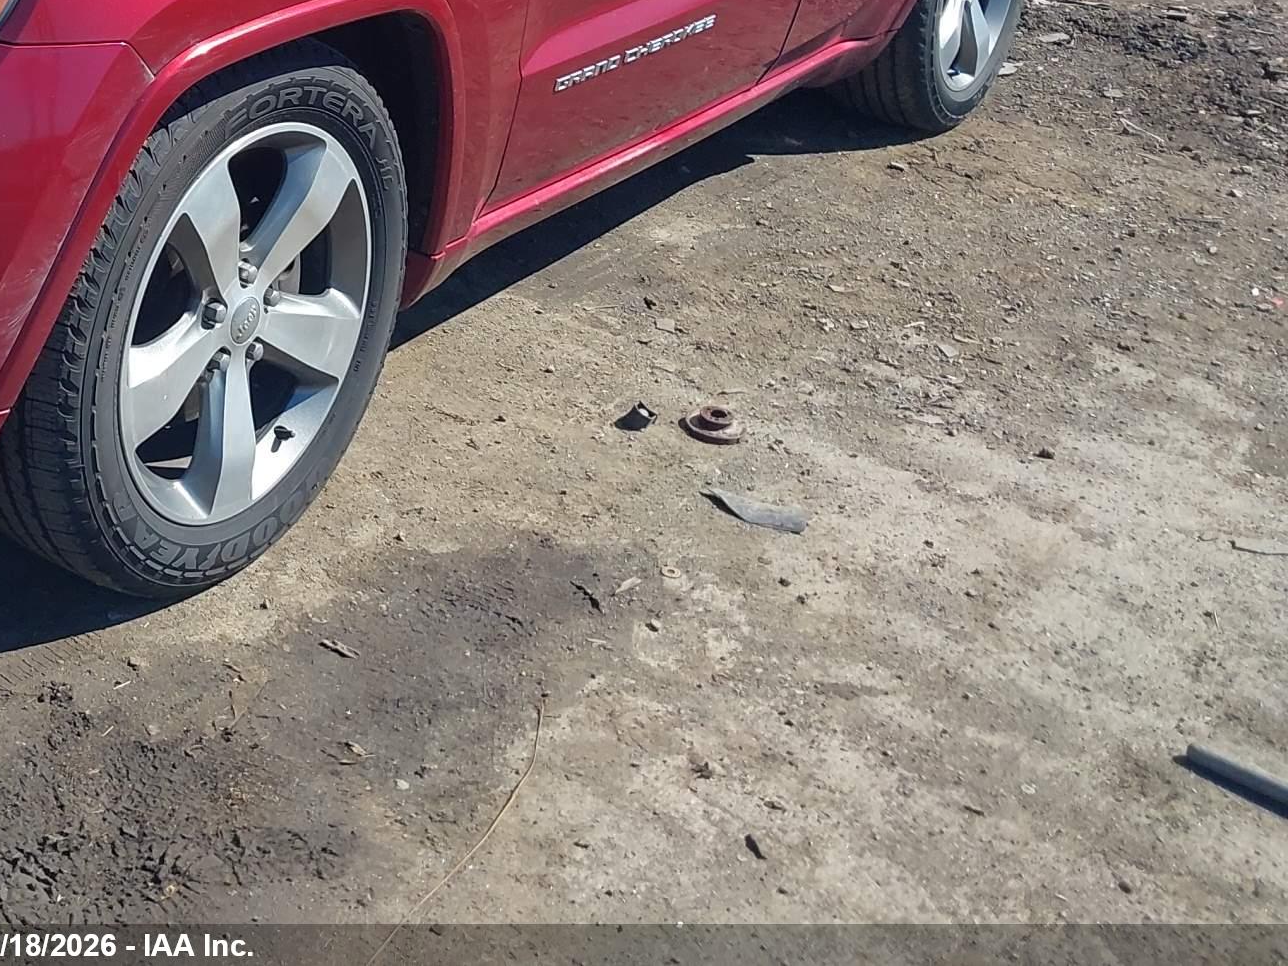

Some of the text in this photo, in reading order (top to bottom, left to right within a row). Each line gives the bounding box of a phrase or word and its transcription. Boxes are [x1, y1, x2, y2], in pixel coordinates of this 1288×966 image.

[554, 14, 717, 93] GRAND CHEROKEE
[224, 85, 378, 151] FORTERA
